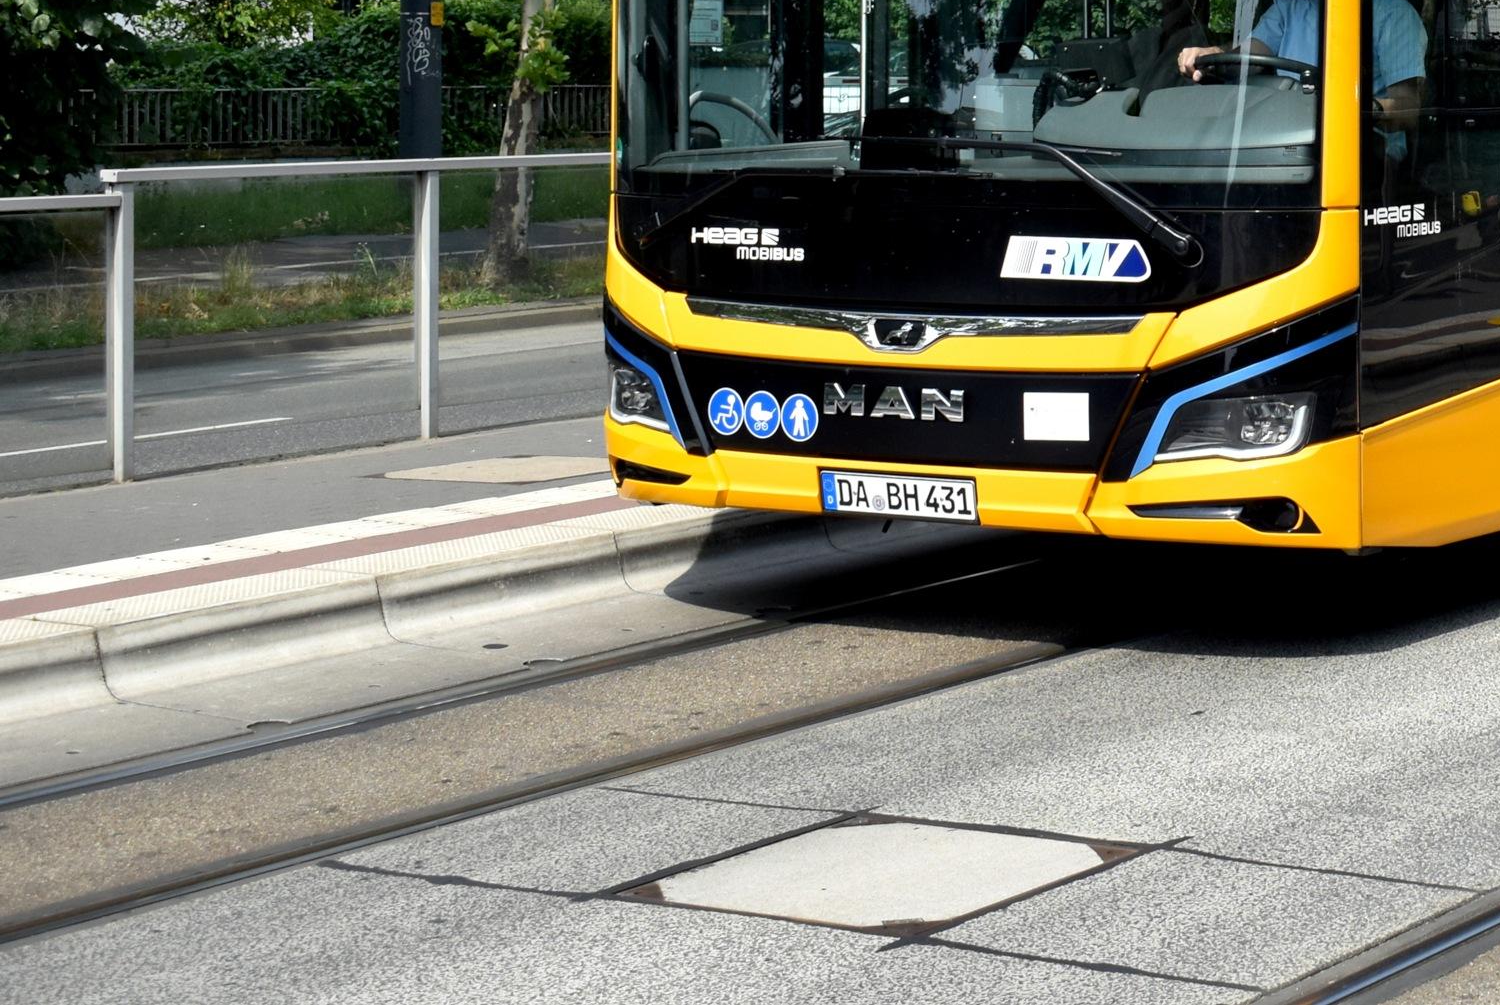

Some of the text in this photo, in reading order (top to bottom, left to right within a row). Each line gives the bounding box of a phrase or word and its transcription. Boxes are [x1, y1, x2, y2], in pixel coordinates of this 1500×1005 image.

[1397, 220, 1441, 238] MOBIBUS
[736, 246, 805, 262] MOBIBUS
[1030, 240, 1136, 278] RMV
[823, 382, 965, 423] MAN
[837, 479, 973, 516] DA BH 431
